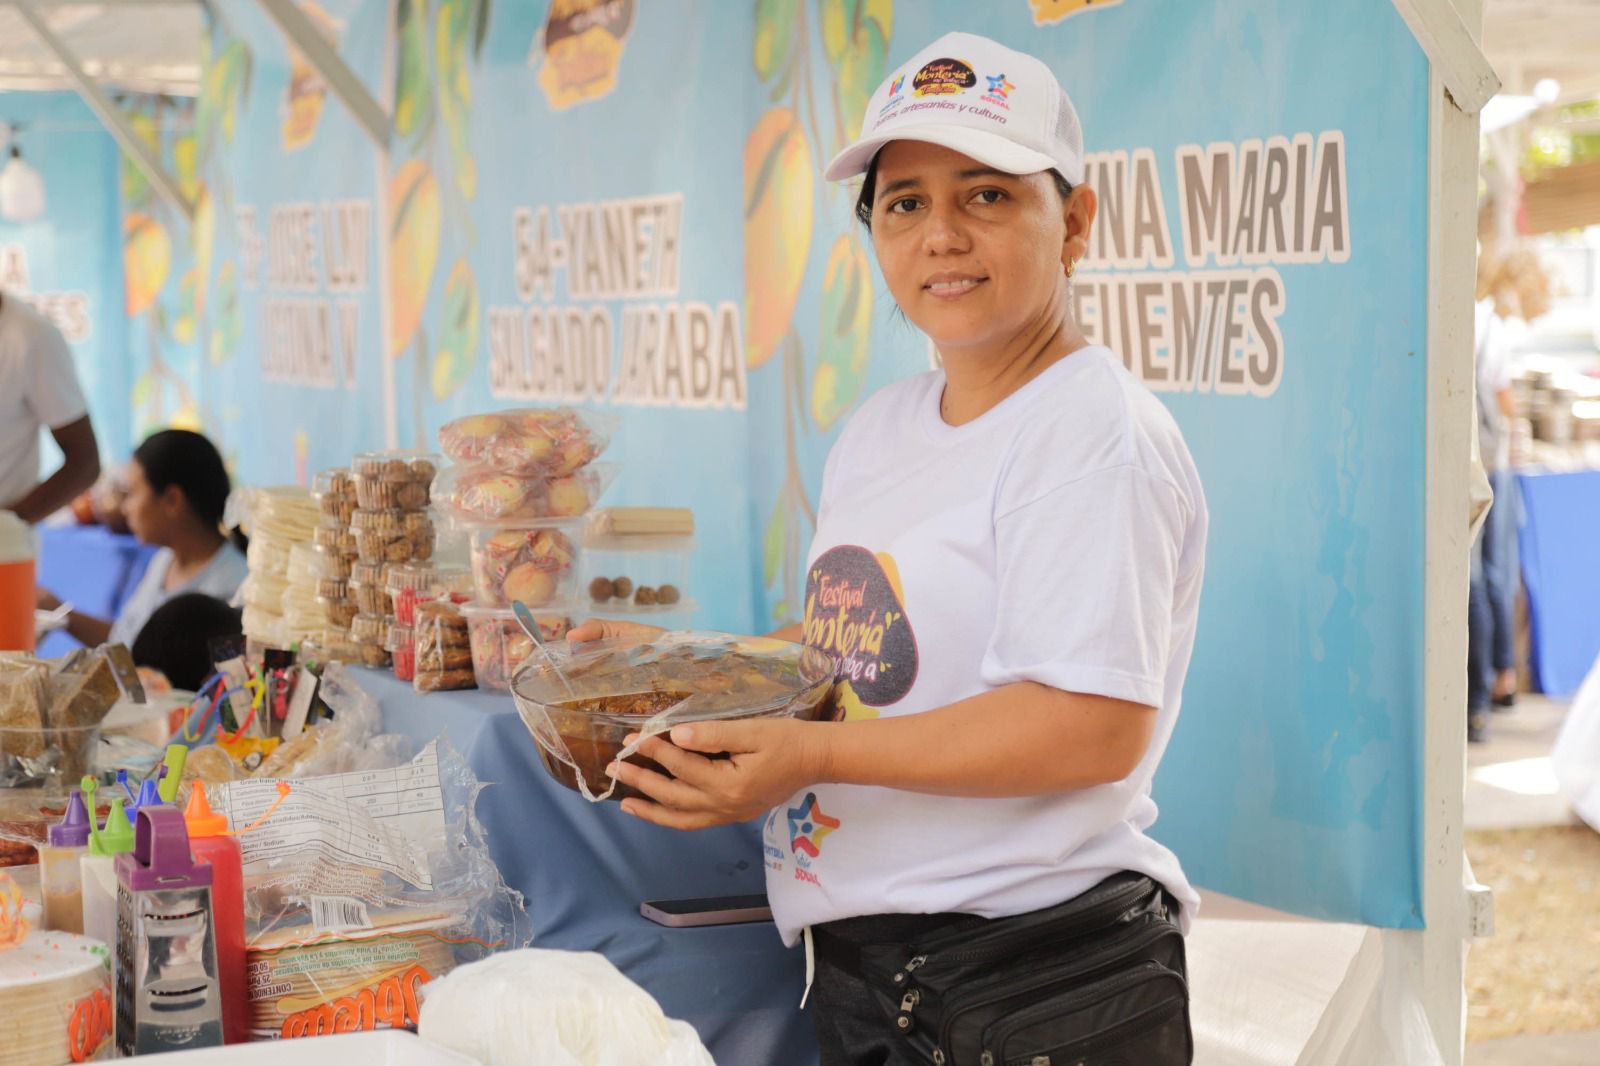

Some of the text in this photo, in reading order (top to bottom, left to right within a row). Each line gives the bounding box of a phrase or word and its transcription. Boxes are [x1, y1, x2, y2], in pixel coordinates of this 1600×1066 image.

[959, 104, 968, 113] y
[968, 105, 1007, 124] cultura
[1181, 140, 1345, 256] MARIA
[489, 307, 611, 398] SALGADO
[820, 574, 868, 610] Festival
